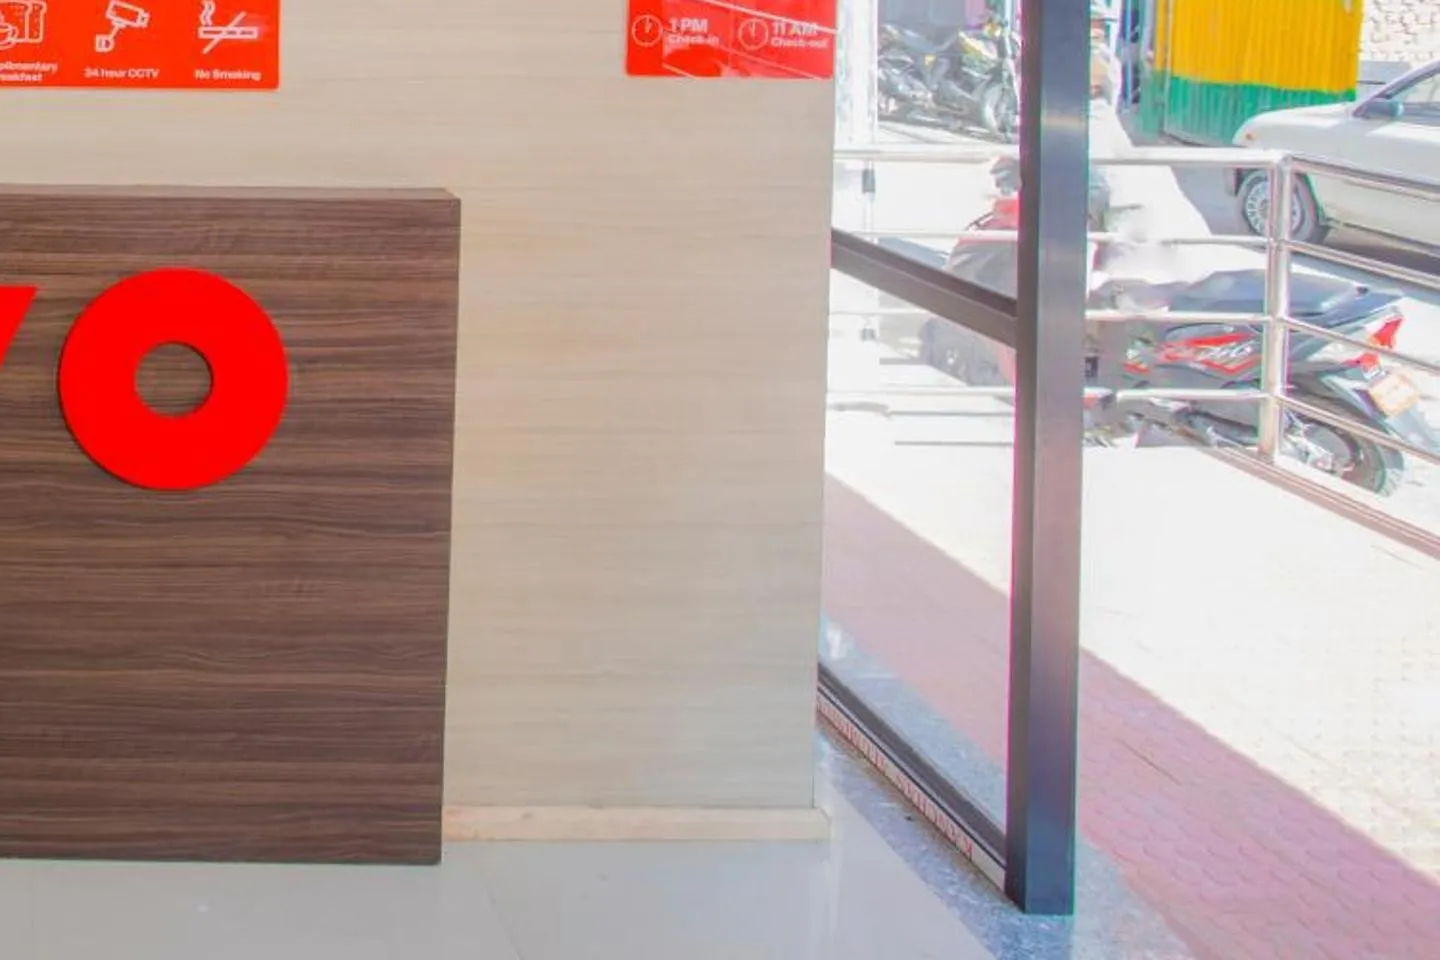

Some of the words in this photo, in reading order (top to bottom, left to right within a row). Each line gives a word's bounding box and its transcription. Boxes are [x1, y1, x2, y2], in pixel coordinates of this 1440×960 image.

[681, 18, 709, 34] PM
[128, 67, 160, 79] CCTV
[195, 68, 211, 80] No
[212, 69, 262, 82] Smoking
